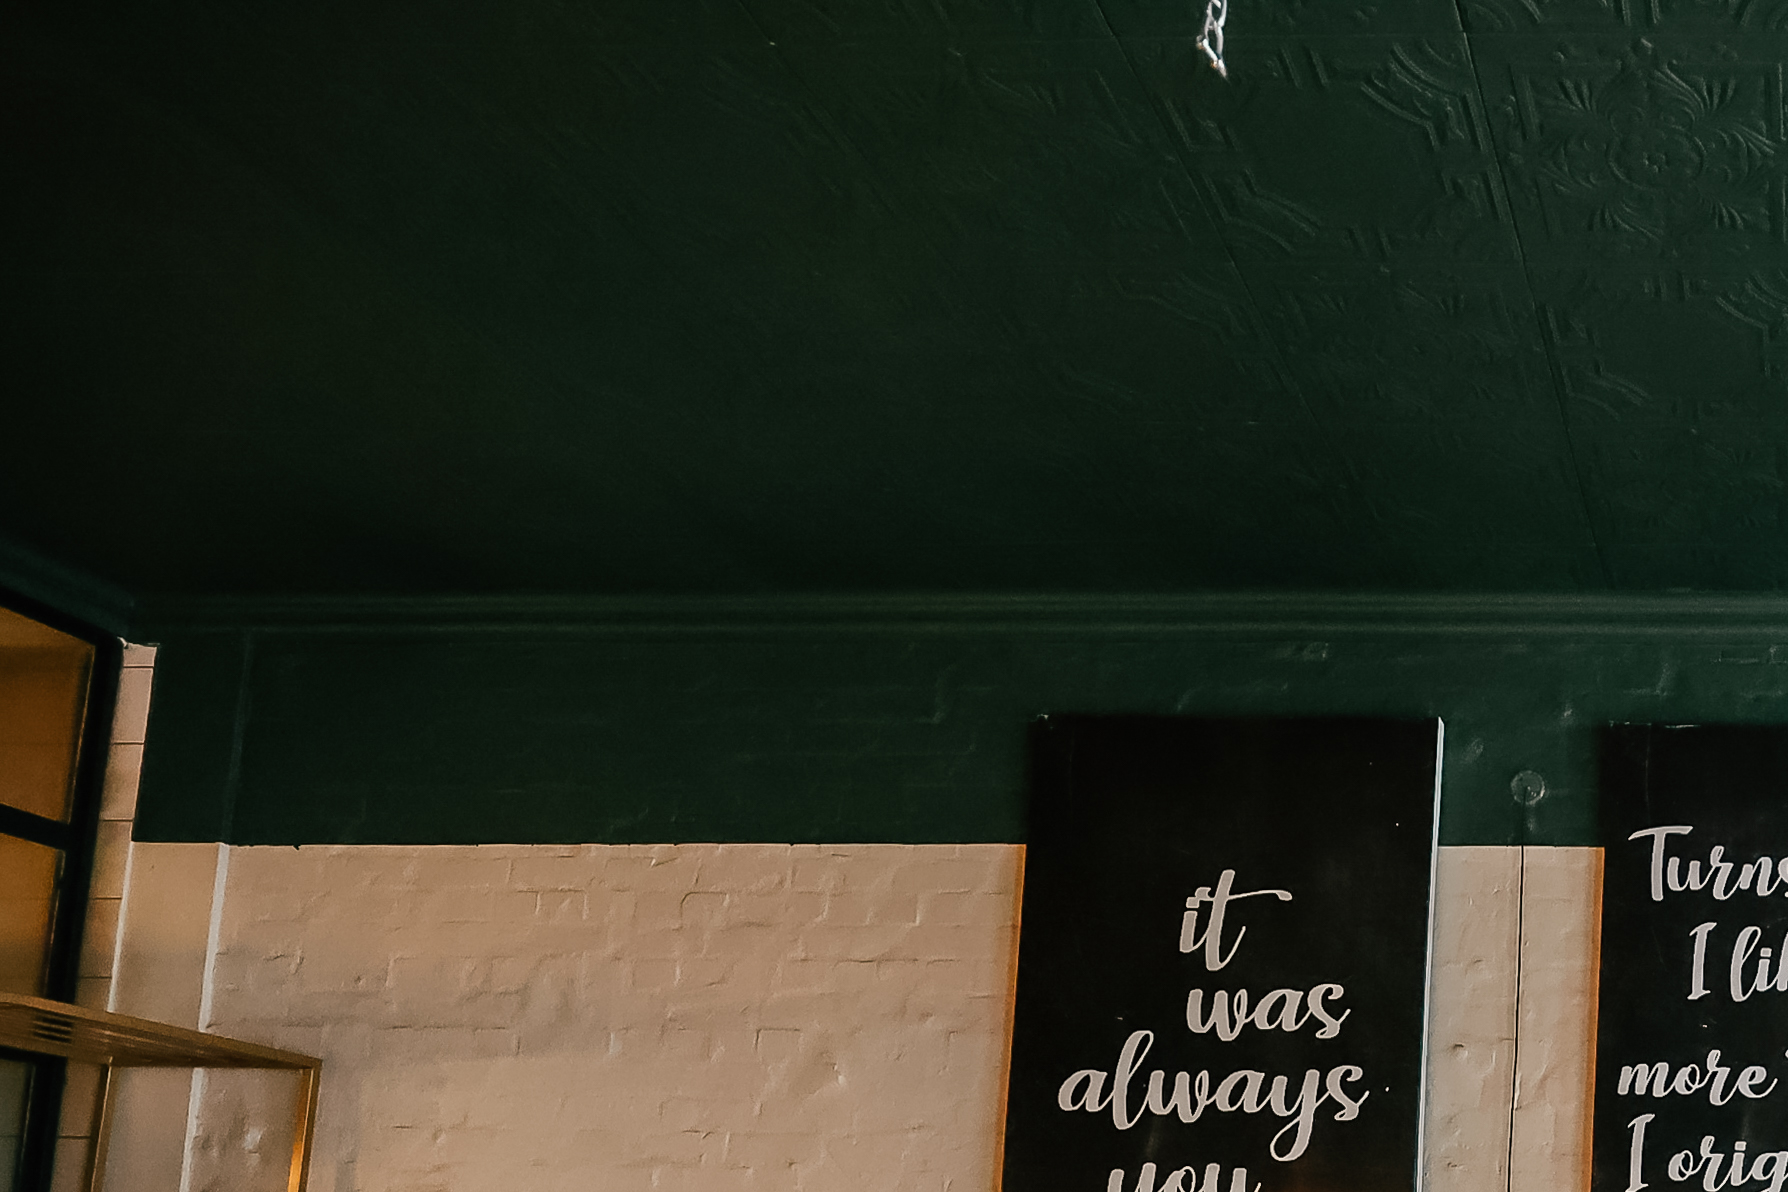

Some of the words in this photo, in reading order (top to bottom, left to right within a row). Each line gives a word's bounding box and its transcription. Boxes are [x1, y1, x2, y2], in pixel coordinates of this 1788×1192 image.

[1180, 869, 1292, 971] it
[1687, 922, 1717, 1000] I
[1187, 984, 1350, 1041] was
[1058, 1030, 1369, 1161] always
[1618, 1049, 1778, 1106] more
[1625, 1114, 1655, 1192] I
